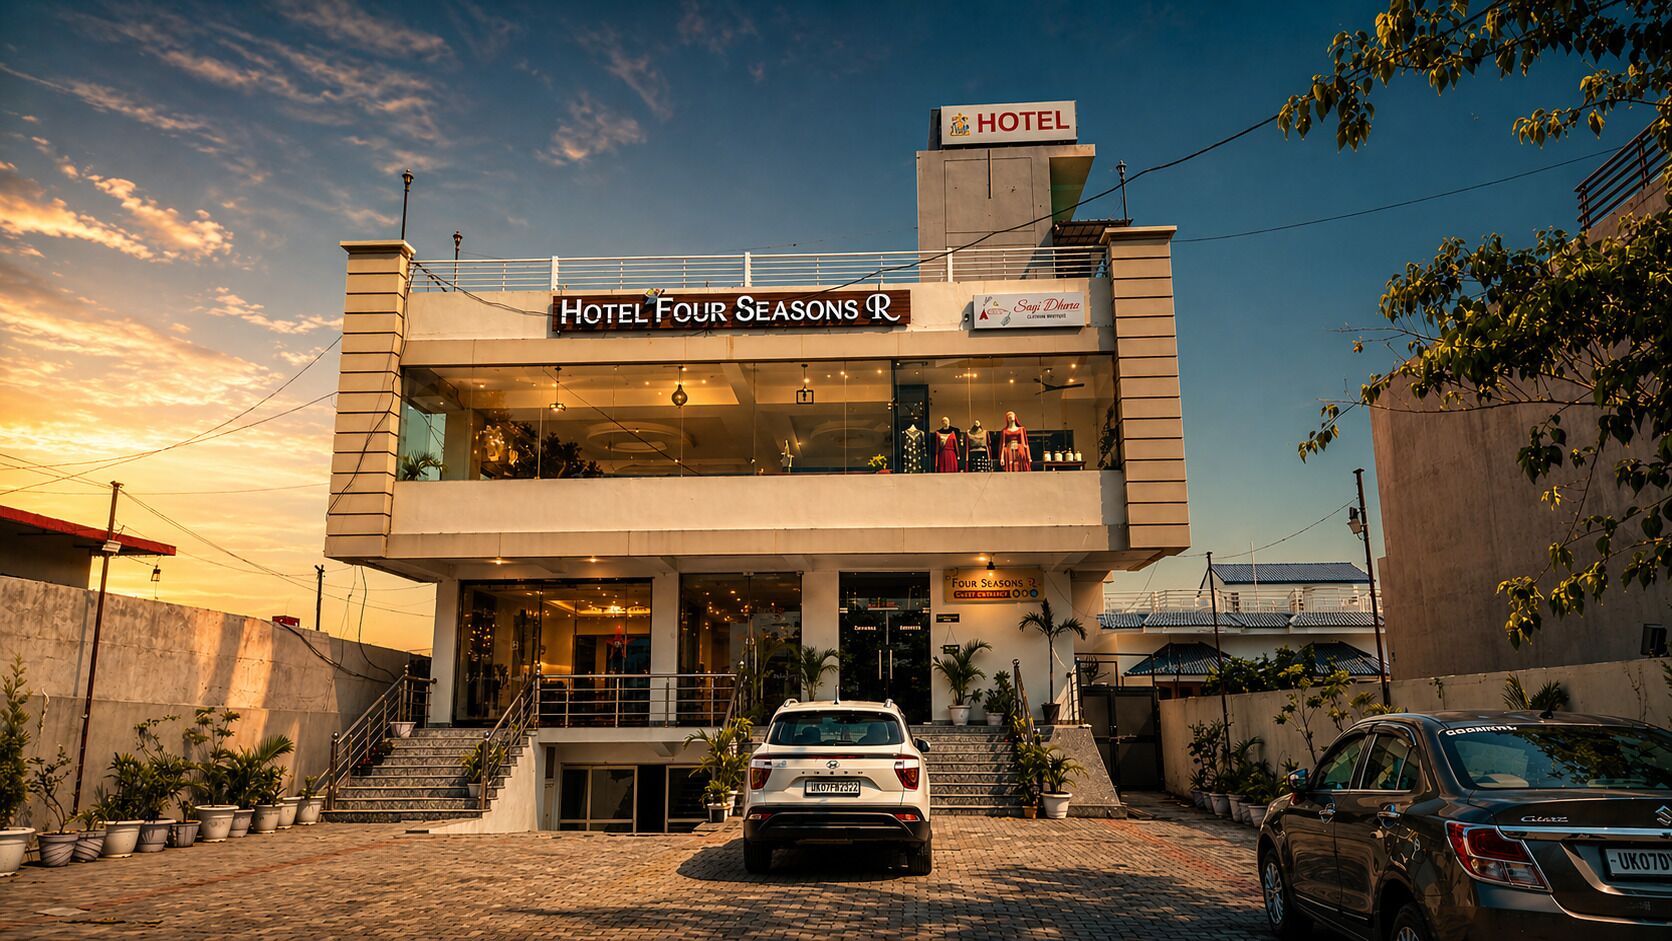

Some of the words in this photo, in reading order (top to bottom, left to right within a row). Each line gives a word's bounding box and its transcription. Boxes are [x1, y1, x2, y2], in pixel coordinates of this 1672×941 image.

[977, 111, 1070, 133] HOTEL
[560, 298, 649, 325] HOTEL
[656, 297, 728, 323] FOUR
[735, 295, 859, 322] SEASONS
[865, 293, 901, 322] R
[952, 578, 978, 588] FOUR
[981, 578, 1024, 588] SEASONS
